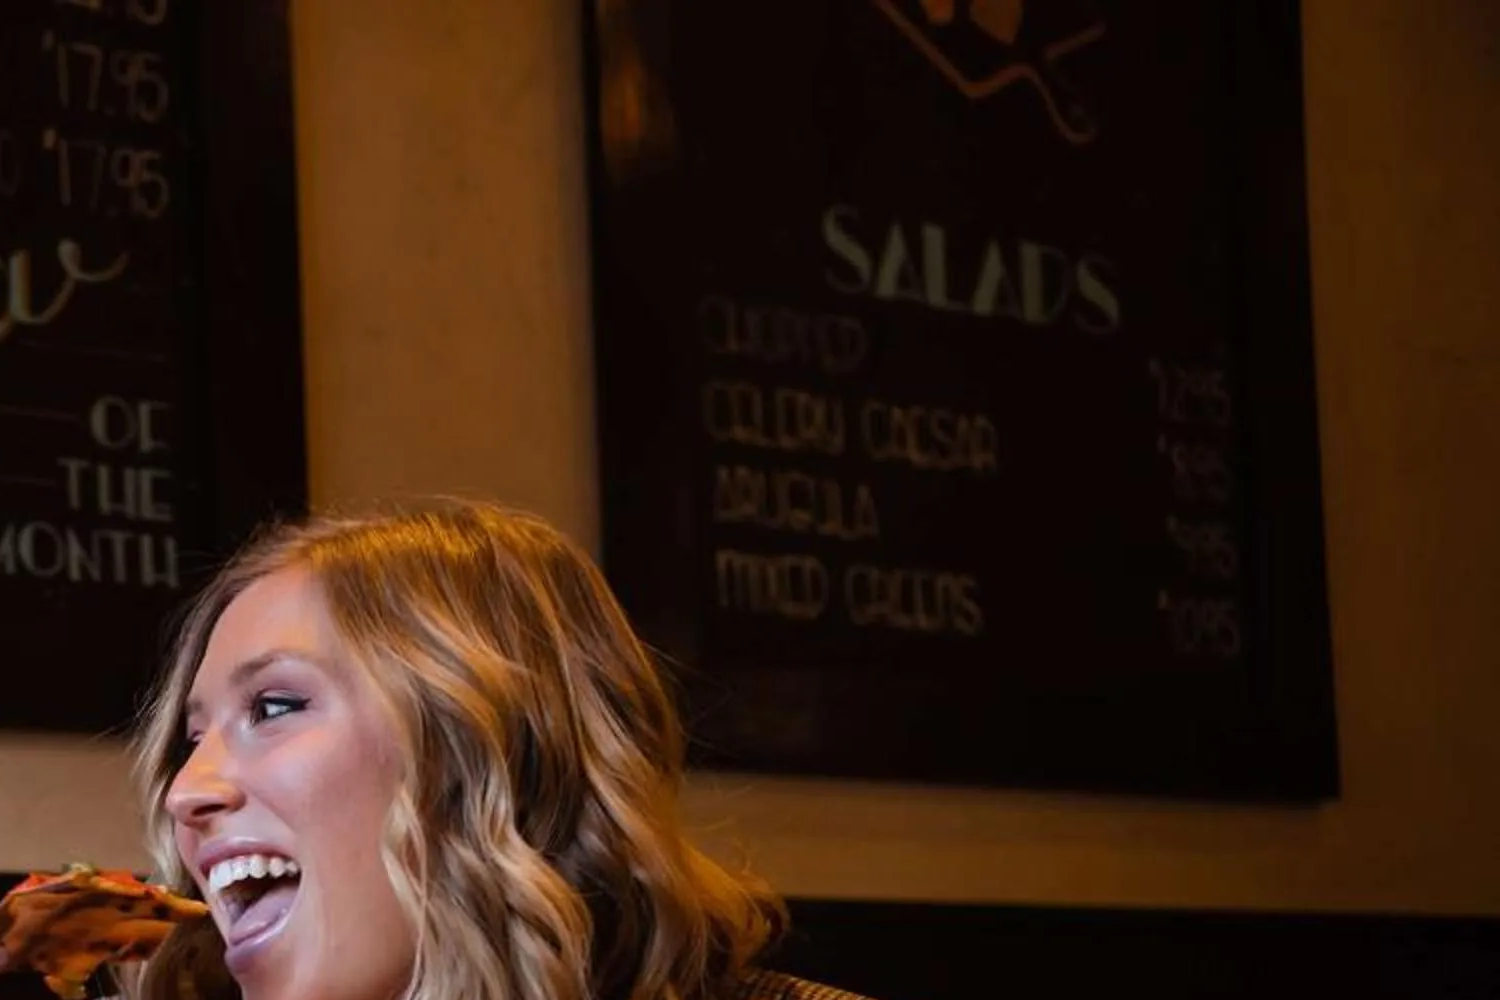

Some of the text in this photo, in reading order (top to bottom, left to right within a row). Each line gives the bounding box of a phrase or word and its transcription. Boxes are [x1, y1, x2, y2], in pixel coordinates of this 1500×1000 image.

[821, 202, 1122, 336] SALADS
[88, 394, 174, 455] OF
[55, 456, 176, 523] THE
